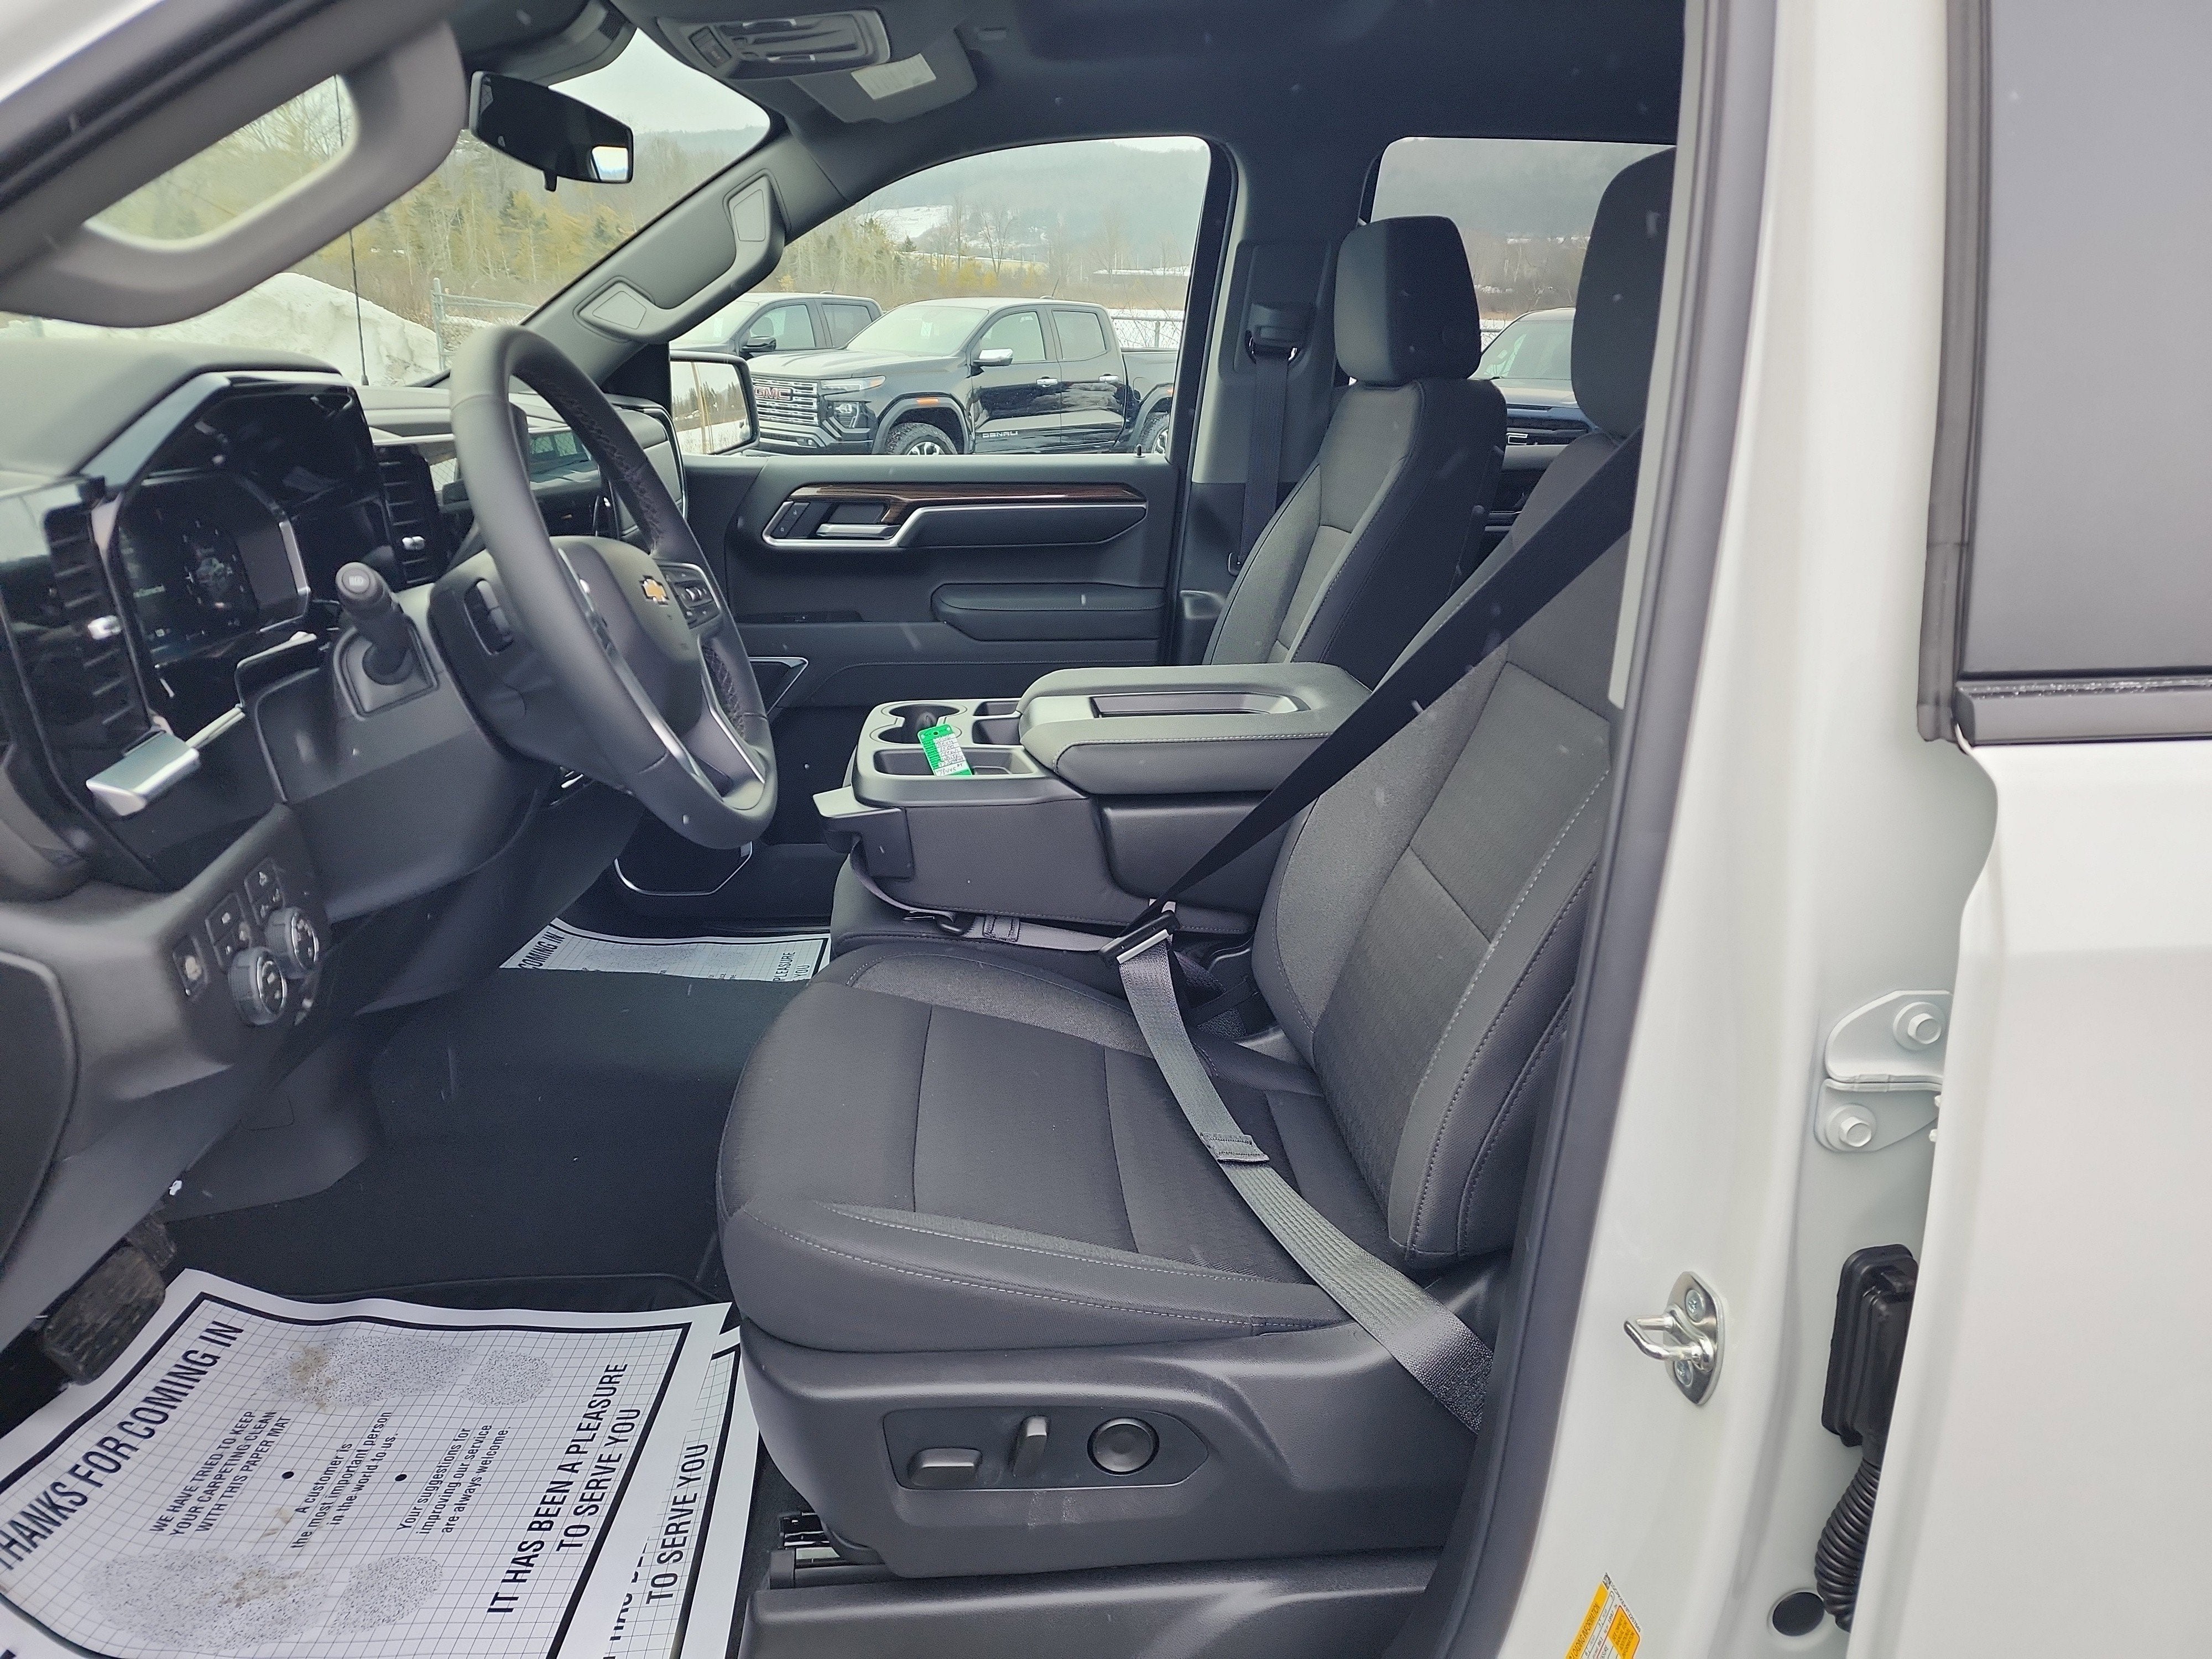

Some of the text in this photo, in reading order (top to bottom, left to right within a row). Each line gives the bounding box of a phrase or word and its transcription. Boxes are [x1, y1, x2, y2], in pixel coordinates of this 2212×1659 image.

[754, 387, 791, 400] GMC
[542, 931, 565, 943] IN
[773, 952, 795, 981] PLEASURE
[794, 965, 810, 978] YOU
[67, 1436, 140, 1489] FOR
[117, 1349, 221, 1439] COMING
[198, 1321, 244, 1348] IN
[149, 1411, 255, 1532] WE HAVE TRIED TO KEEP
[169, 1411, 277, 1536] YOUR CARPETING CLEAN
[195, 1416, 291, 1532] WITH THIS PAPER MAT
[290, 1412, 392, 1548] the most important person
[304, 1455, 344, 1503] customer
[336, 1443, 352, 1452] is
[326, 1433, 399, 1525] in the world to us.
[397, 1428, 471, 1531] Your suggestions for
[416, 1425, 492, 1535] improving our service
[441, 1426, 511, 1533] are always welcome.
[487, 1363, 629, 1613] IT HAS BEEN A PLEASURE
[555, 1409, 641, 1552] TO SERVE YOU
[645, 1444, 709, 1604] TO SERVE YOU
[1582, 1603, 1600, 1635] INFORMATION
